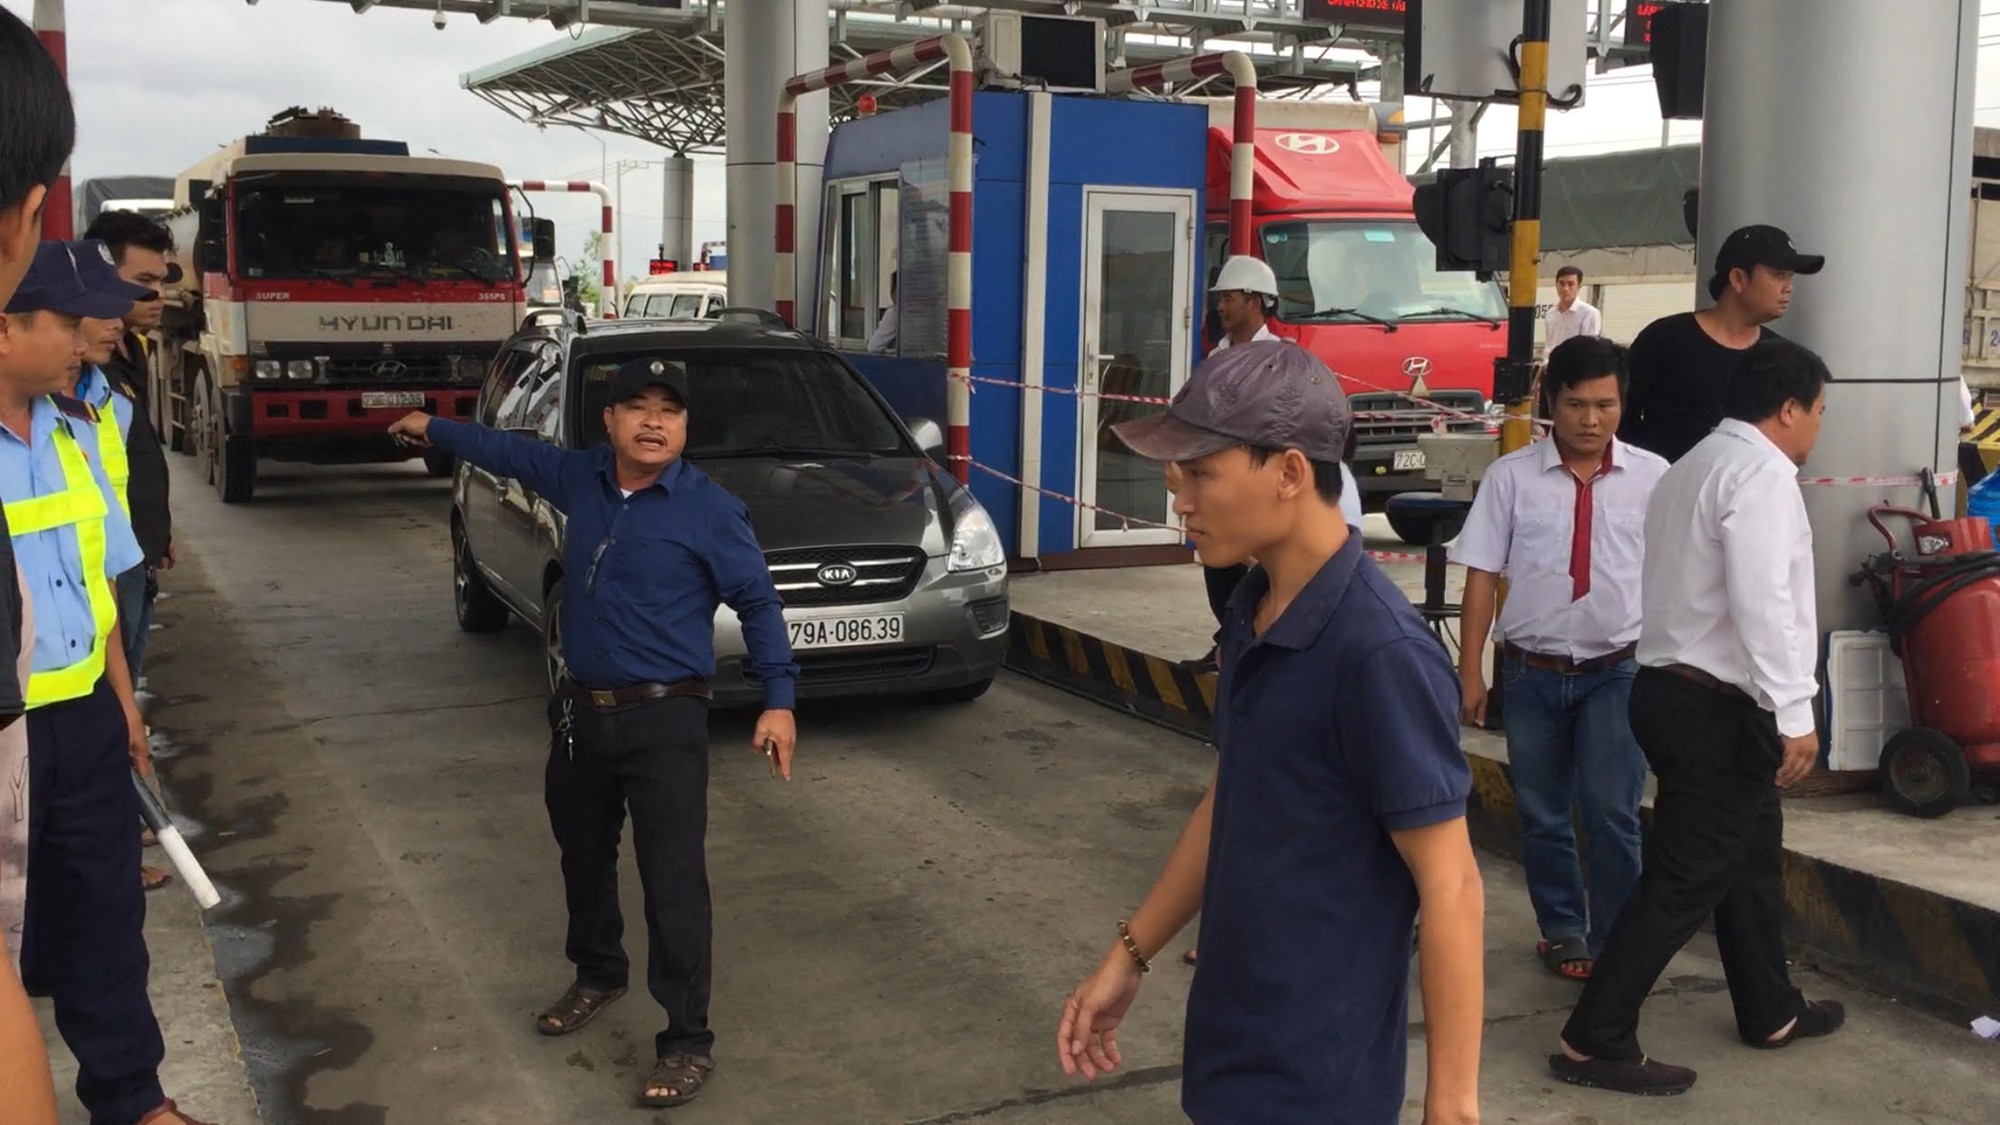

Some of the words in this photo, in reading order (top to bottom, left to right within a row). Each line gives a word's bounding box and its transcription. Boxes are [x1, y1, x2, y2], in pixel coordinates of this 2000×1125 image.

[256, 292, 290, 300] SUPER
[319, 315, 453, 331] HYUNDAI
[824, 569, 850, 579] KIA
